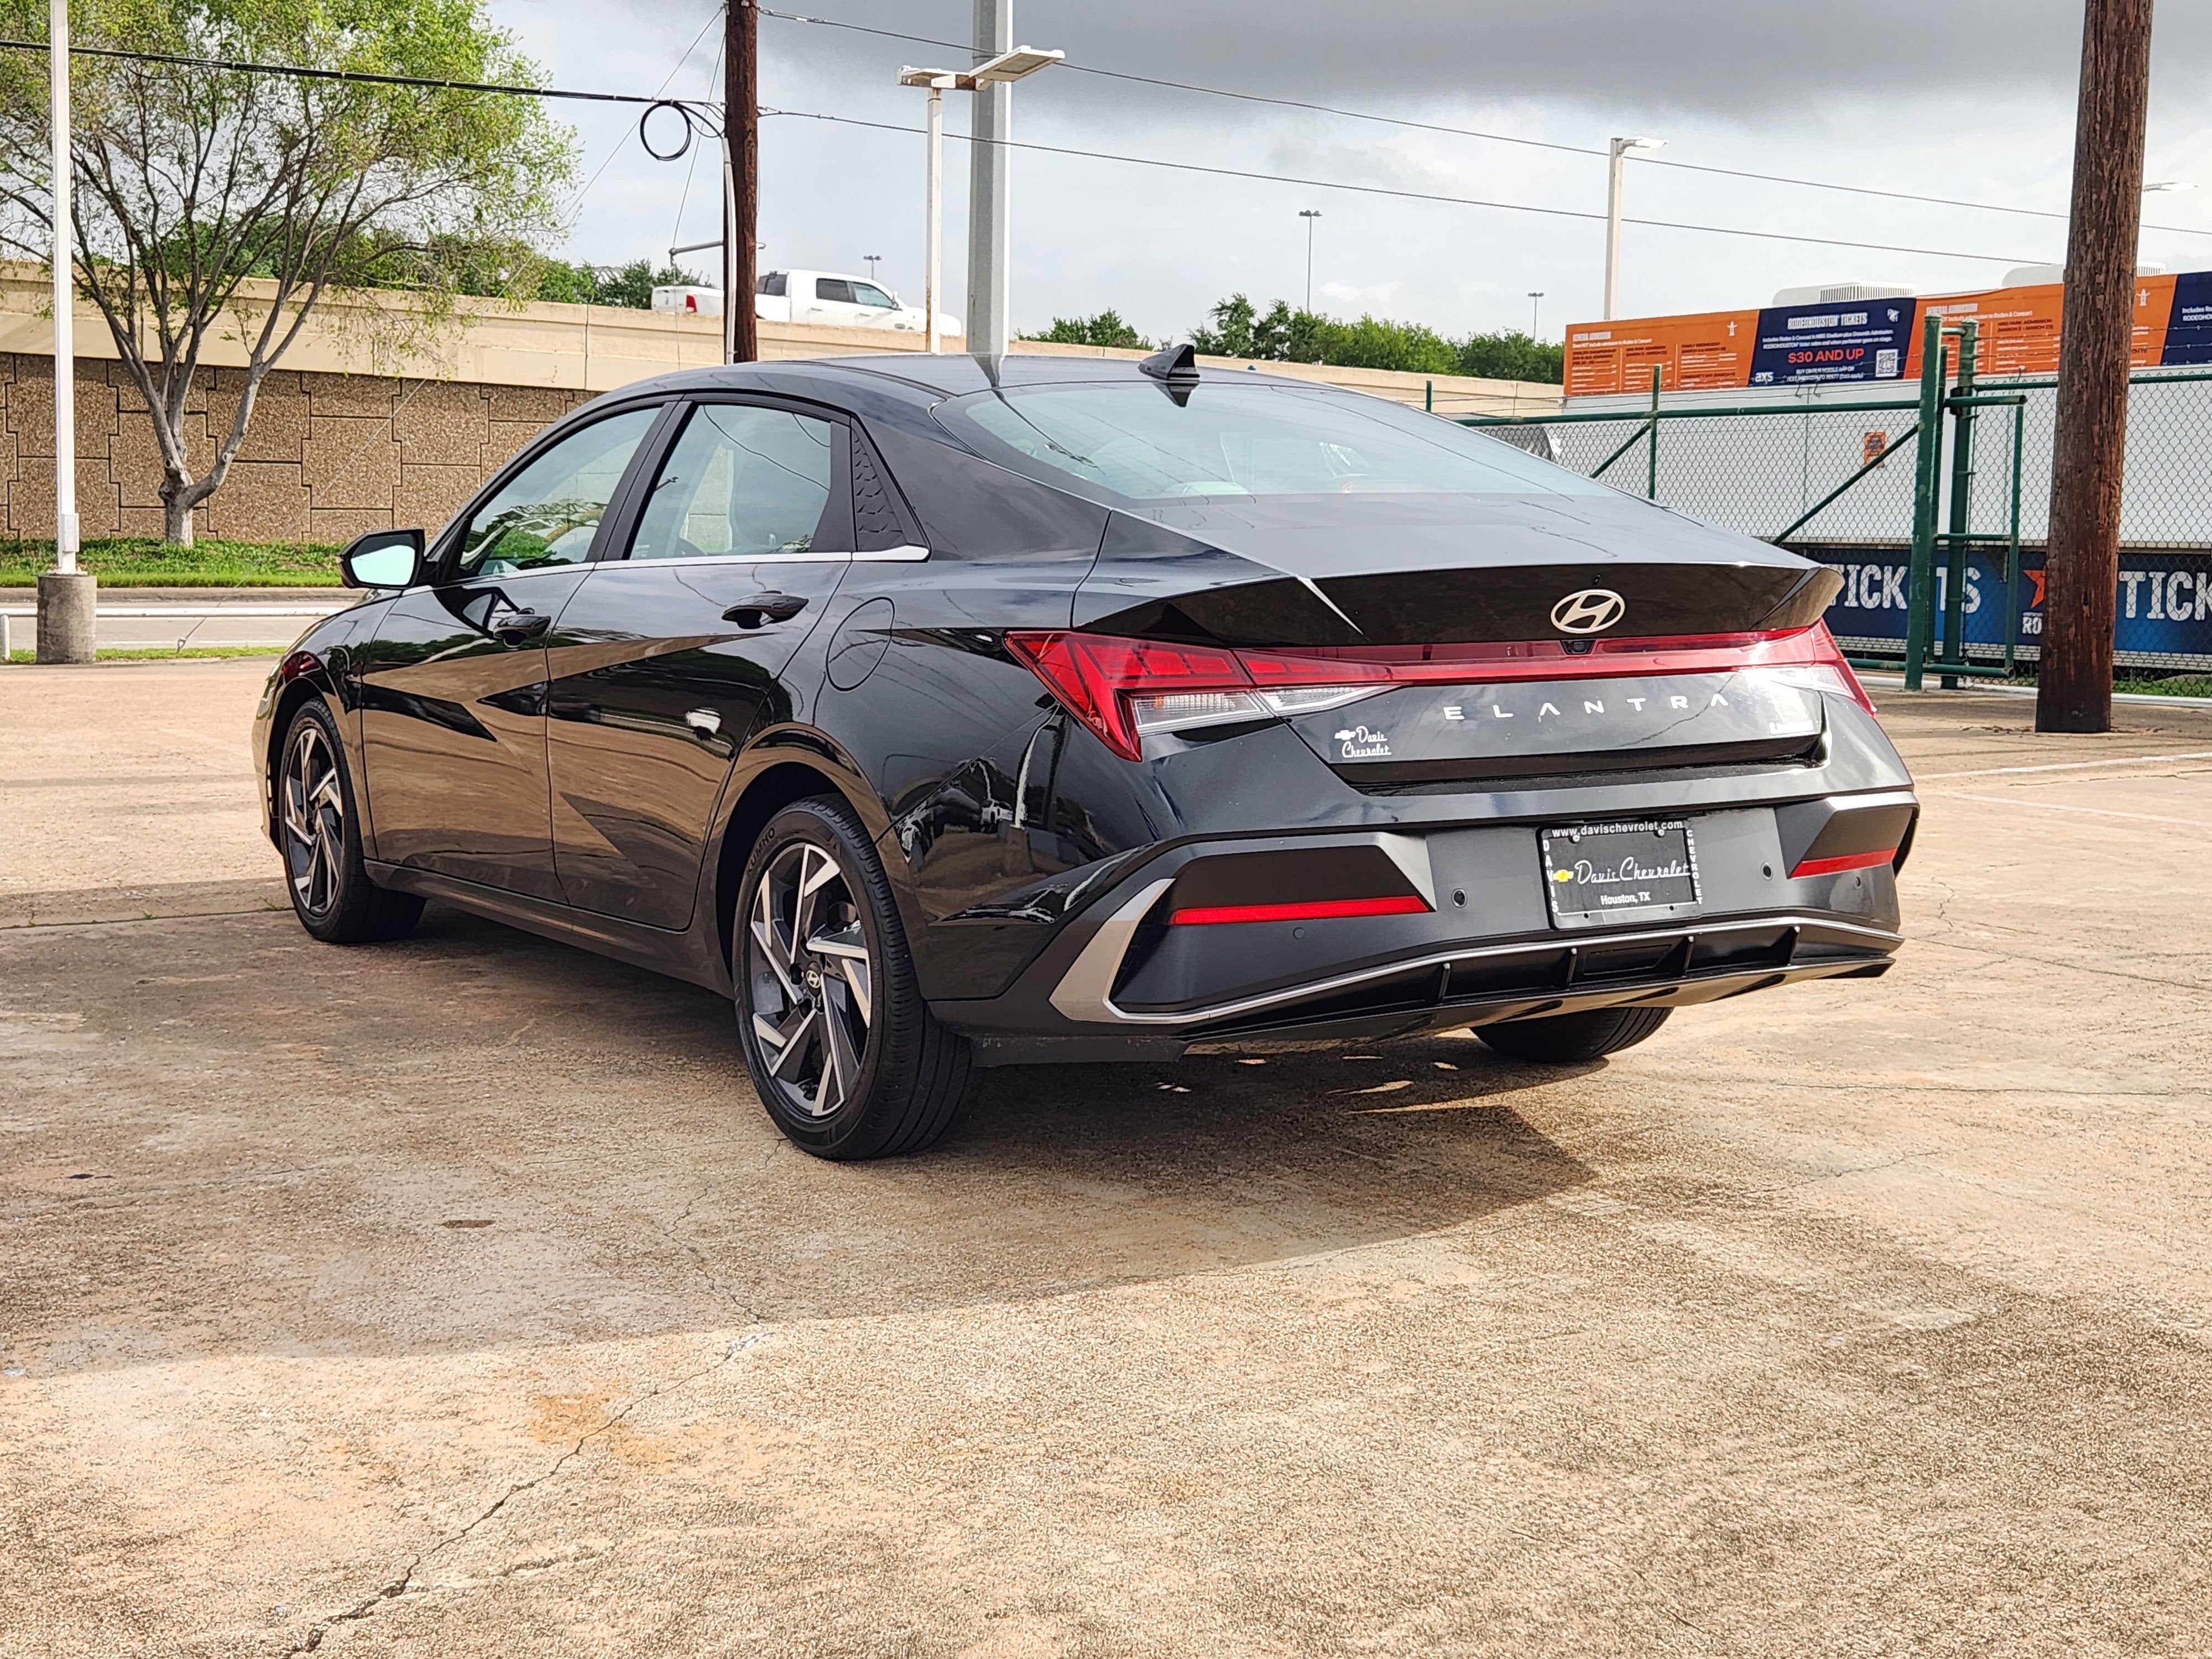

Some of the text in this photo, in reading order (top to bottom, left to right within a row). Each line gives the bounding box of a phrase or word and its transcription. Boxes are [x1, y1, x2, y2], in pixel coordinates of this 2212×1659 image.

[1814, 349, 1844, 362] AND
[1846, 348, 1865, 361] UP
[1755, 371, 1775, 385] axs
[1443, 693, 1729, 721] ELANTRA
[1356, 726, 1388, 743] Davis
[1342, 741, 1392, 758] Chevrolet
[1552, 821, 1683, 838] www.davischevrolet.com
[1542, 839, 1559, 913] DAVIS
[1574, 856, 1691, 885] Davis Chevrolet
[1686, 830, 1703, 905] CHEVROLET
[1600, 891, 1651, 906] Houston, TX
